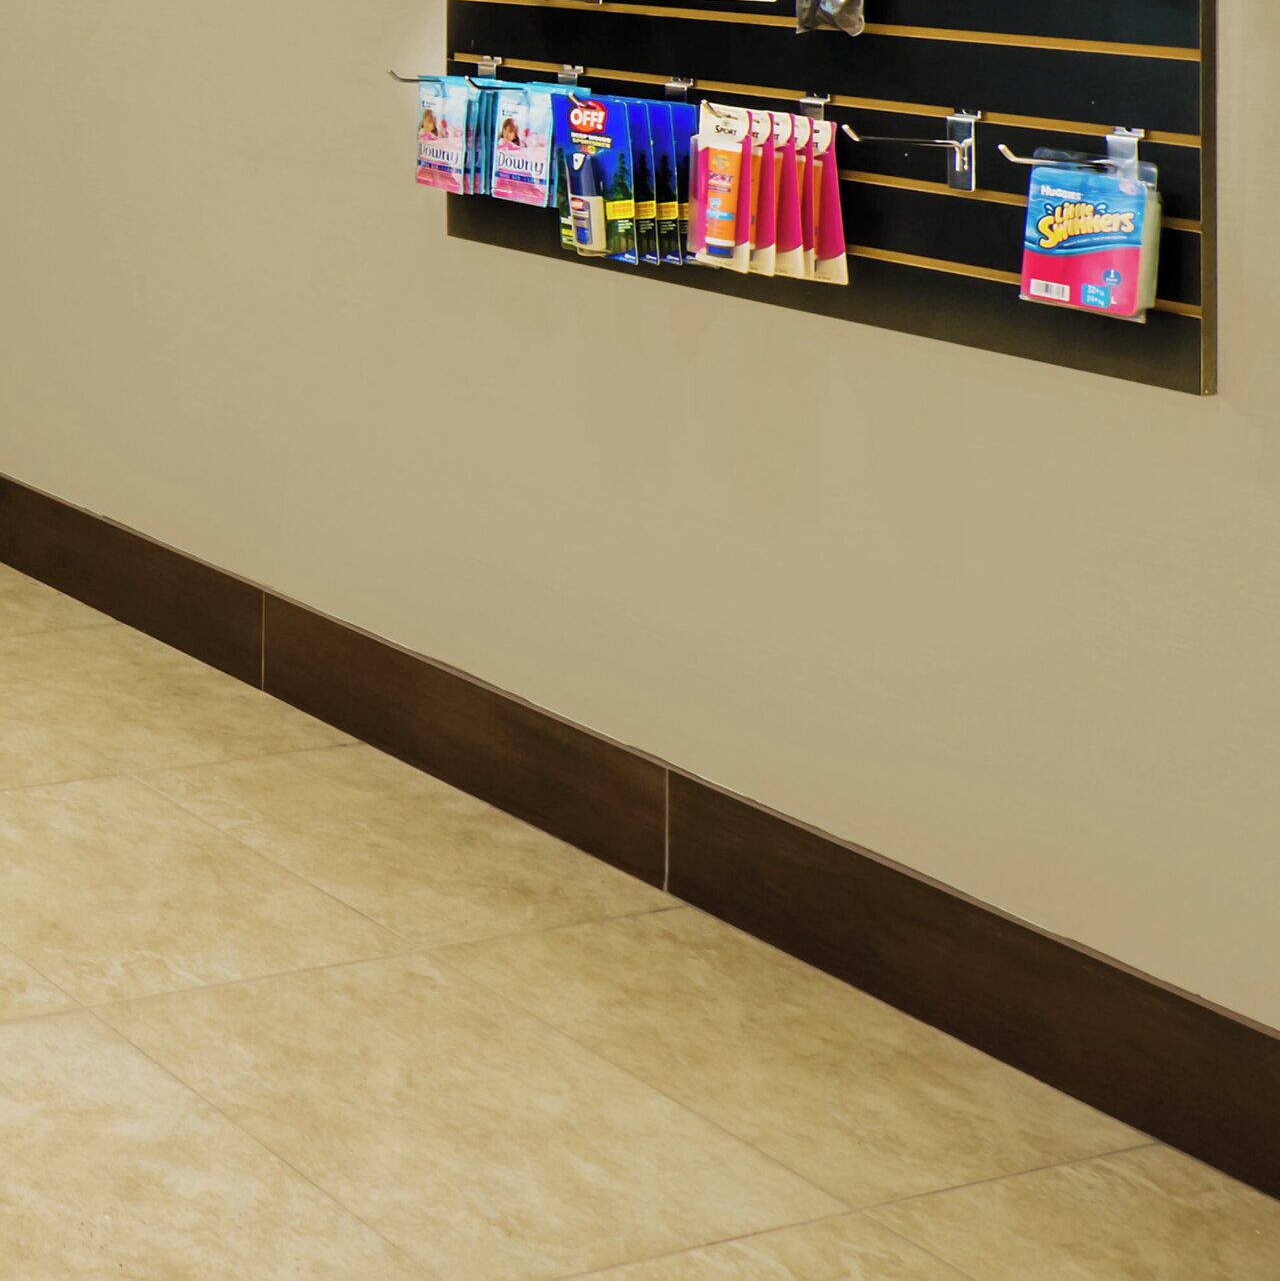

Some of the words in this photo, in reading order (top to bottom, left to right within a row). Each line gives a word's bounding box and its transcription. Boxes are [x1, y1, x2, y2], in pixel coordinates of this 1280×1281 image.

[570, 107, 606, 130] OFF!
[418, 142, 460, 165] Downy
[497, 150, 545, 175] Downy
[1054, 201, 1095, 223] Little
[1037, 210, 1135, 249] Swimmers
